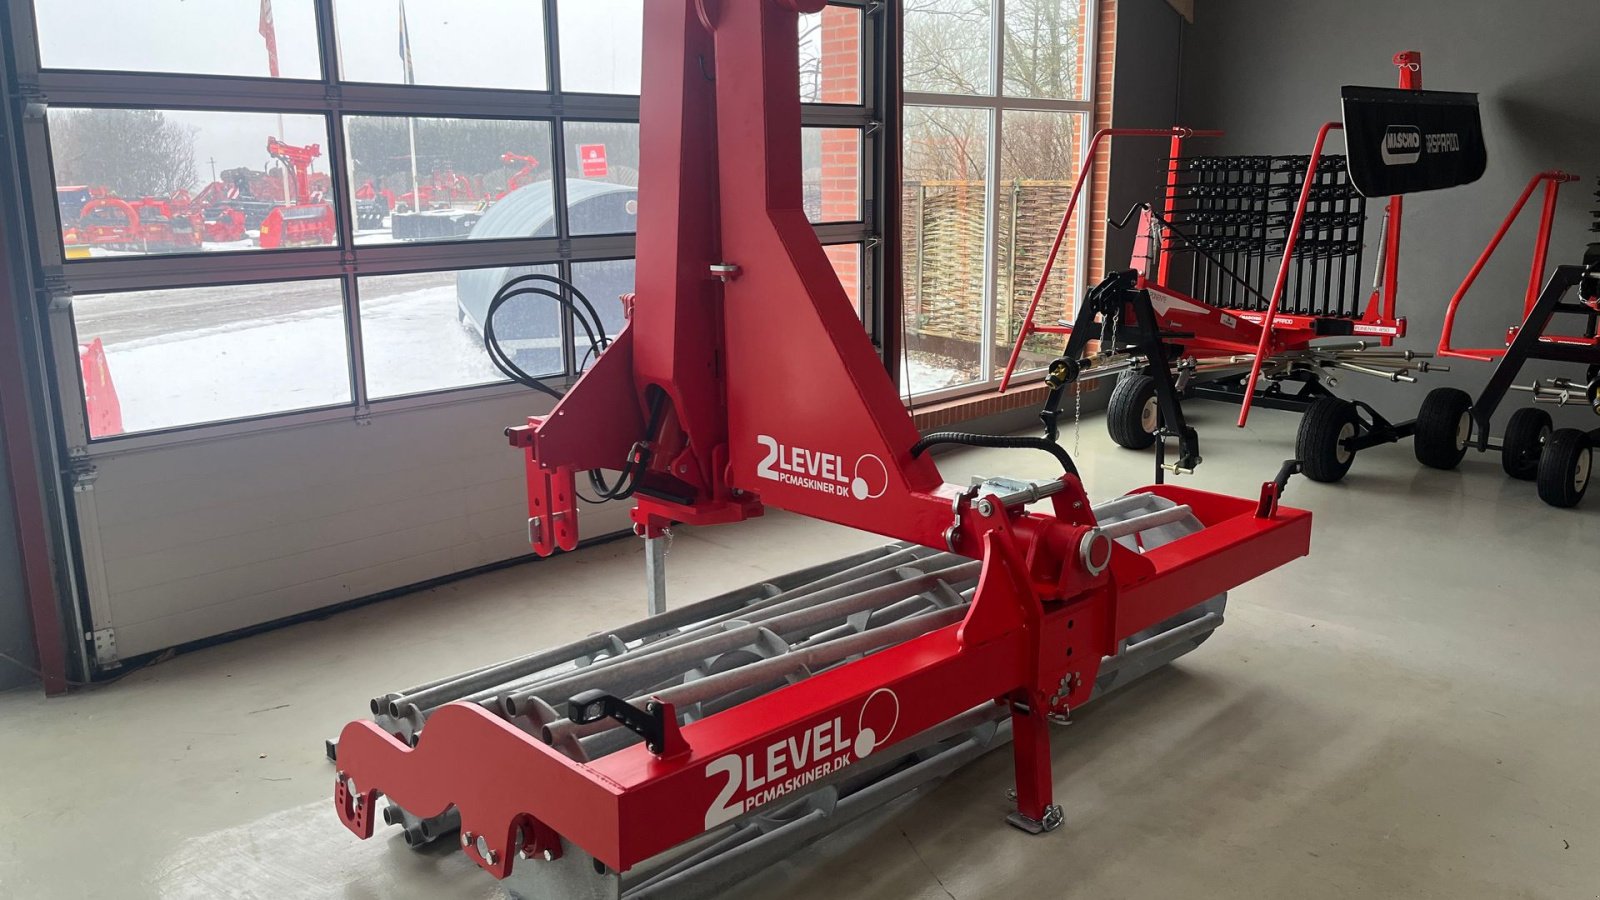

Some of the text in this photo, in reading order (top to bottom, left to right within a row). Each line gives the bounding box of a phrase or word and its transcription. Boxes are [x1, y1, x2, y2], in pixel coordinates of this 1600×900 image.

[1387, 132, 1420, 149] MASCHIO
[780, 472, 835, 495] PCMASKINER
[746, 751, 851, 812] PCMASKINER.DK
